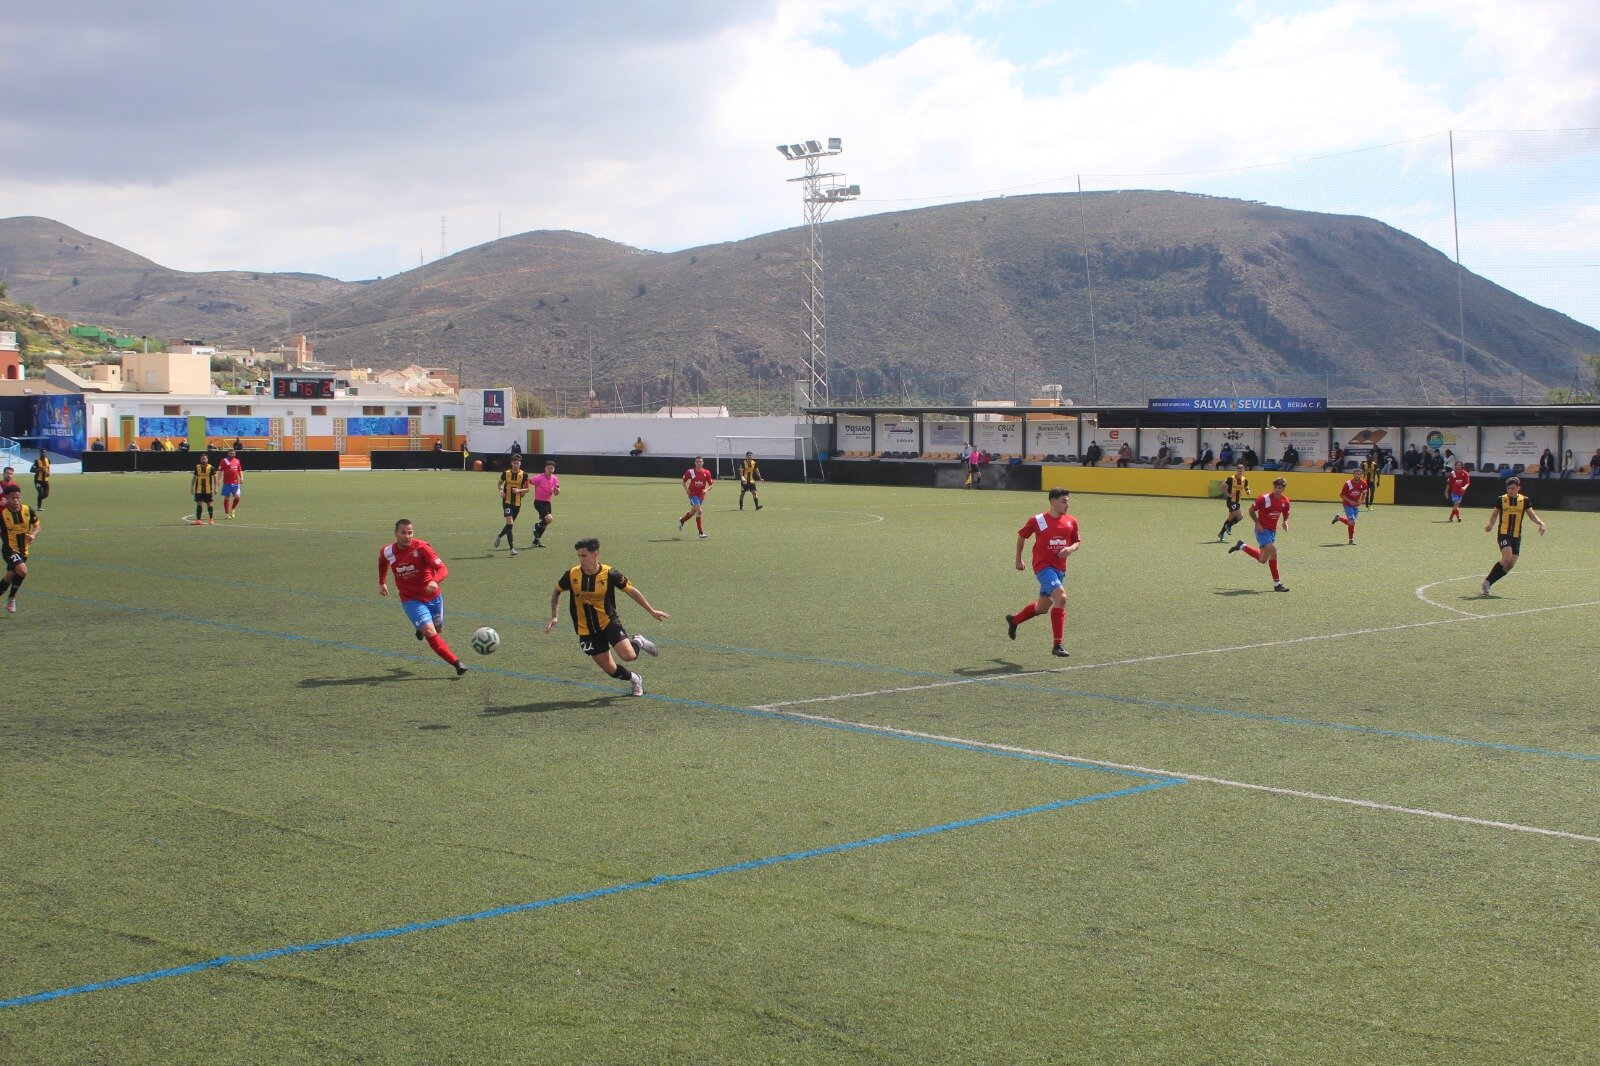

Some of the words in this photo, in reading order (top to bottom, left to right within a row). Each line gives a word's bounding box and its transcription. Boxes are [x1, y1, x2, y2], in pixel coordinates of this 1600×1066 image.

[279, 381, 285, 393] 3
[1193, 399, 1227, 409] SALVA
[1238, 399, 1281, 409] SEVILLA
[43, 428, 56, 436] SALVA
[56, 428, 74, 437] SEVILLA
[997, 424, 1015, 432] CRUZ
[1500, 539, 1508, 547] 18
[11, 553, 22, 562] 21
[581, 641, 595, 652] 22
